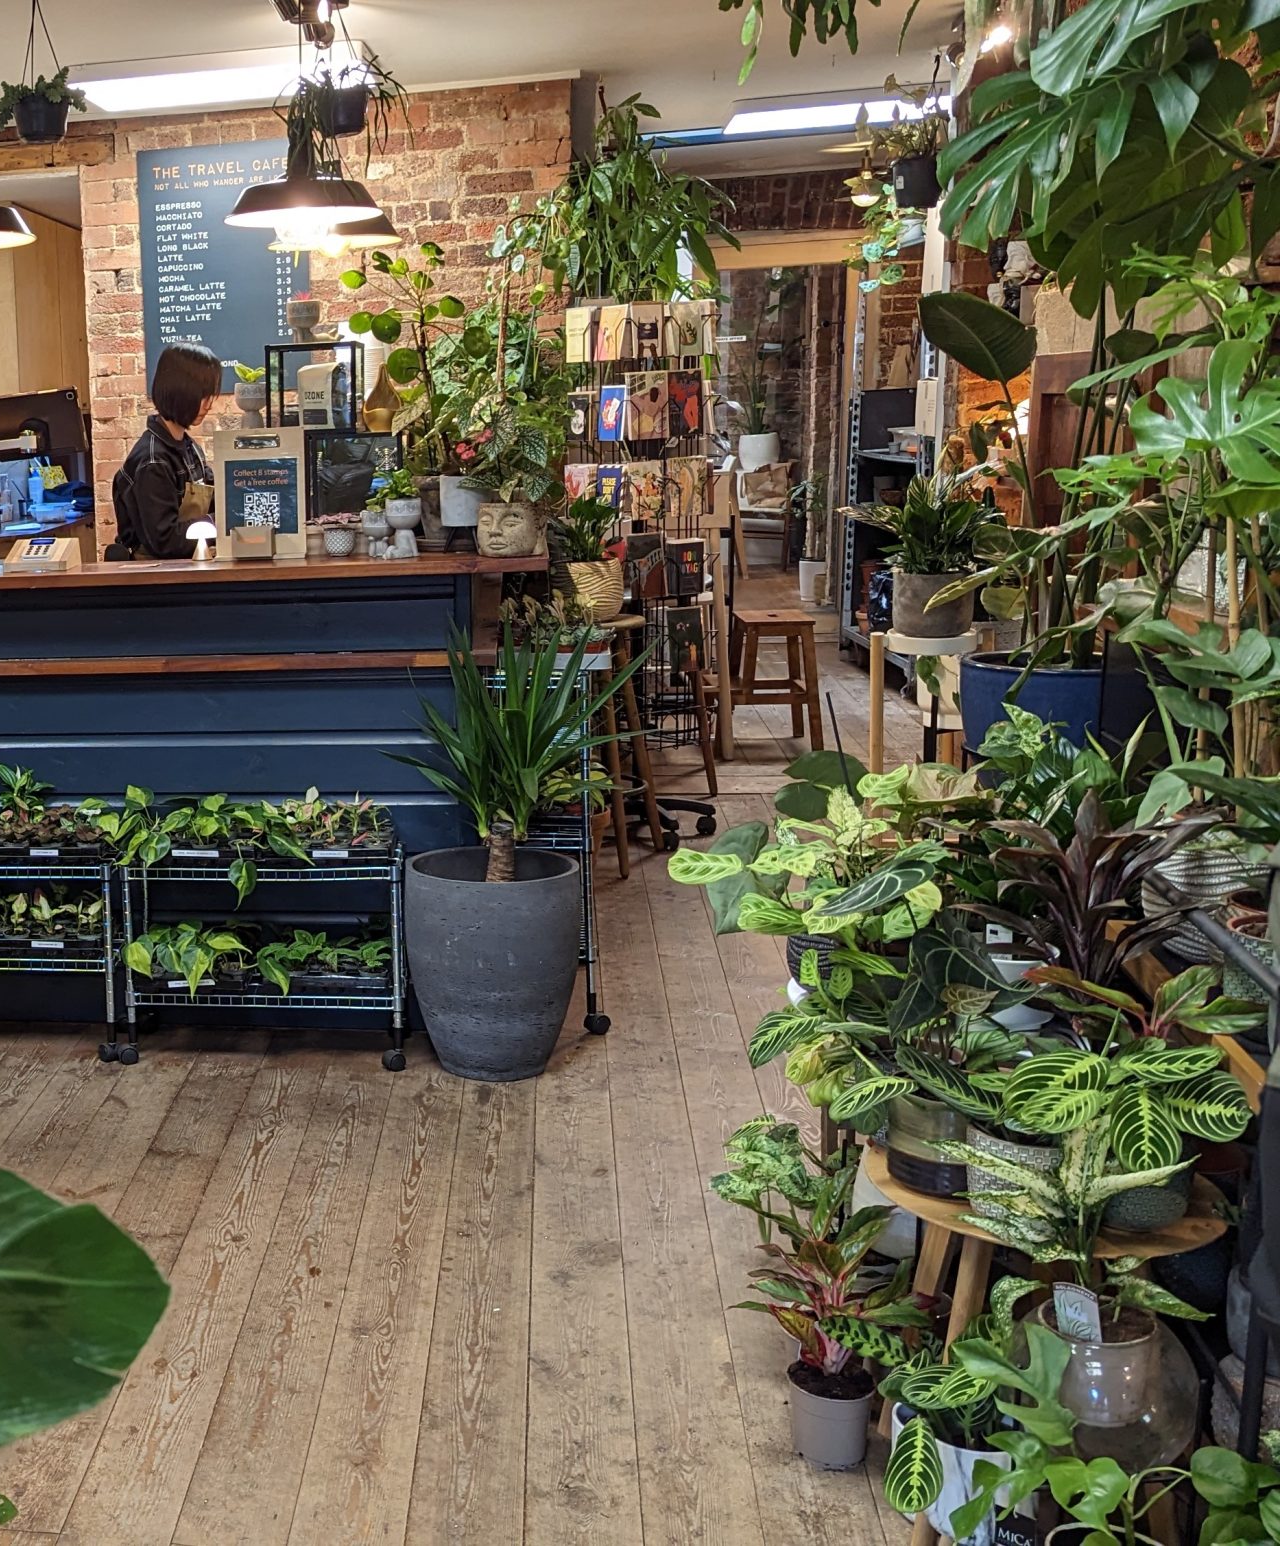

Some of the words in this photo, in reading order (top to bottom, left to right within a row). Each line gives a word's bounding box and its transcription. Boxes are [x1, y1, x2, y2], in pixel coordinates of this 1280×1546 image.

[152, 166, 180, 179] THE
[188, 161, 245, 176] TRAVEL
[252, 157, 288, 171] CAFE
[154, 183, 169, 191] NOT
[174, 181, 190, 190] ALL
[193, 180, 209, 188] WHO
[213, 177, 244, 186] WANDER
[248, 175, 263, 183] ARE
[155, 202, 202, 212] ESSPRESSO
[155, 212, 203, 222] MACCHIATO
[156, 223, 192, 232] CORTADO
[156, 234, 177, 242] FLAT
[181, 231, 209, 241] WHITE
[157, 244, 178, 253] LONG
[182, 242, 209, 251] BLACK
[157, 254, 184, 263] LATTE
[157, 263, 204, 273] CAPUCCINO
[276, 267, 291, 275] 3.3
[158, 274, 185, 283] MOCHA
[276, 277, 291, 285] 3.3
[158, 284, 194, 293] CARAMEL
[199, 281, 226, 290] LATTE
[159, 295, 175, 303] HOT
[179, 292, 226, 302] CHOCOLATE
[159, 304, 191, 314] MATCHA
[196, 302, 222, 311] LATTE
[160, 315, 180, 324] CHAI
[185, 313, 212, 322] LATTE
[160, 326, 177, 334] TEA
[186, 334, 202, 342] TEA
[304, 391, 325, 400] OZONE
[233, 469, 257, 477] Collect
[263, 469, 289, 477] stamps
[233, 479, 246, 487] Get
[267, 477, 289, 485] coffee
